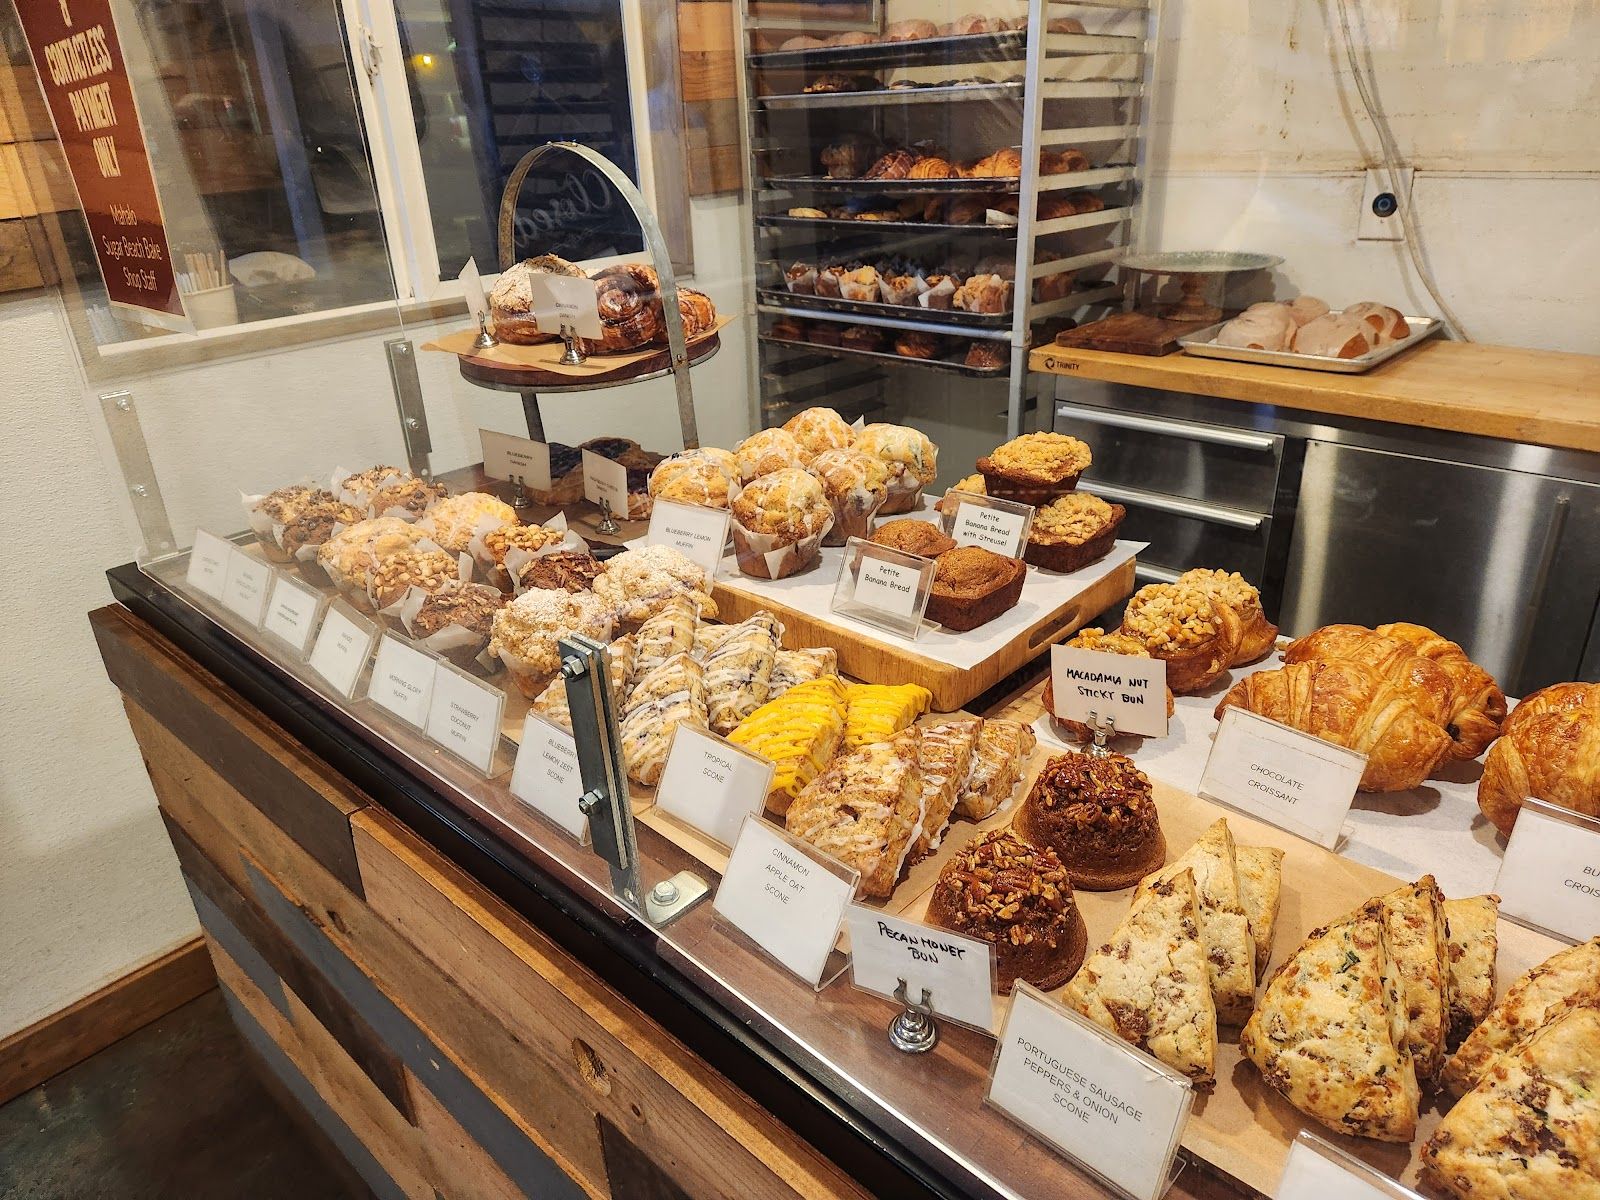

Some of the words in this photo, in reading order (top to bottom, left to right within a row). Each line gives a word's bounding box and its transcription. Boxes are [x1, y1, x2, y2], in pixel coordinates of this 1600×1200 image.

[44, 24, 113, 87] CONTACTLESS
[68, 82, 118, 132] PAYMENT
[92, 135, 121, 178] ONLY
[109, 203, 138, 226] Mahalo
[102, 235, 124, 261] Sugar
[121, 236, 146, 259] Beach
[142, 237, 163, 261] Bake
[122, 266, 142, 293] Shop
[140, 268, 158, 292] Staff
[1056, 361, 1080, 370] TRINITY
[965, 519, 988, 531] Banana
[989, 525, 1011, 537] Bread
[979, 511, 1001, 523] Petite
[665, 526, 693, 538] BLUEBERRY
[693, 534, 712, 542] LEMON
[675, 540, 694, 549] MUFFIN
[962, 530, 977, 541] with
[978, 533, 1008, 547] Streusel
[879, 565, 900, 578] Petite
[864, 573, 888, 587] Banana
[889, 580, 911, 593] Bread
[1066, 668, 1122, 686] MACADAMIA
[1129, 678, 1150, 690] NUT
[1077, 685, 1117, 702] STICKY
[1122, 693, 1145, 705] BUN
[450, 702, 480, 722] STRAWBERRY
[450, 715, 472, 731] COCONUT
[548, 738, 577, 759] BLUEBERRY
[542, 751, 560, 767] LEMON
[556, 758, 574, 773] ZEST
[703, 751, 733, 772] TROPICAL
[546, 768, 564, 785] SCONE
[702, 767, 725, 784] SCONE
[1249, 762, 1305, 792] CHOCOLATE
[1247, 778, 1299, 806] CROISSANT
[771, 847, 810, 877] CINNAMON
[765, 864, 789, 886] APPLE
[788, 878, 805, 895] OAT
[764, 882, 790, 905] SCONE
[877, 920, 918, 946] PECAN
[907, 947, 939, 964] BUN
[1016, 1036, 1089, 1089] PORTUGUESE
[1088, 1082, 1144, 1123] SAUSAGE
[1023, 1057, 1072, 1094] PEPPERS
[1072, 1088, 1081, 1100] &
[1081, 1094, 1120, 1125] ONION
[1051, 1092, 1091, 1125] SCONE
